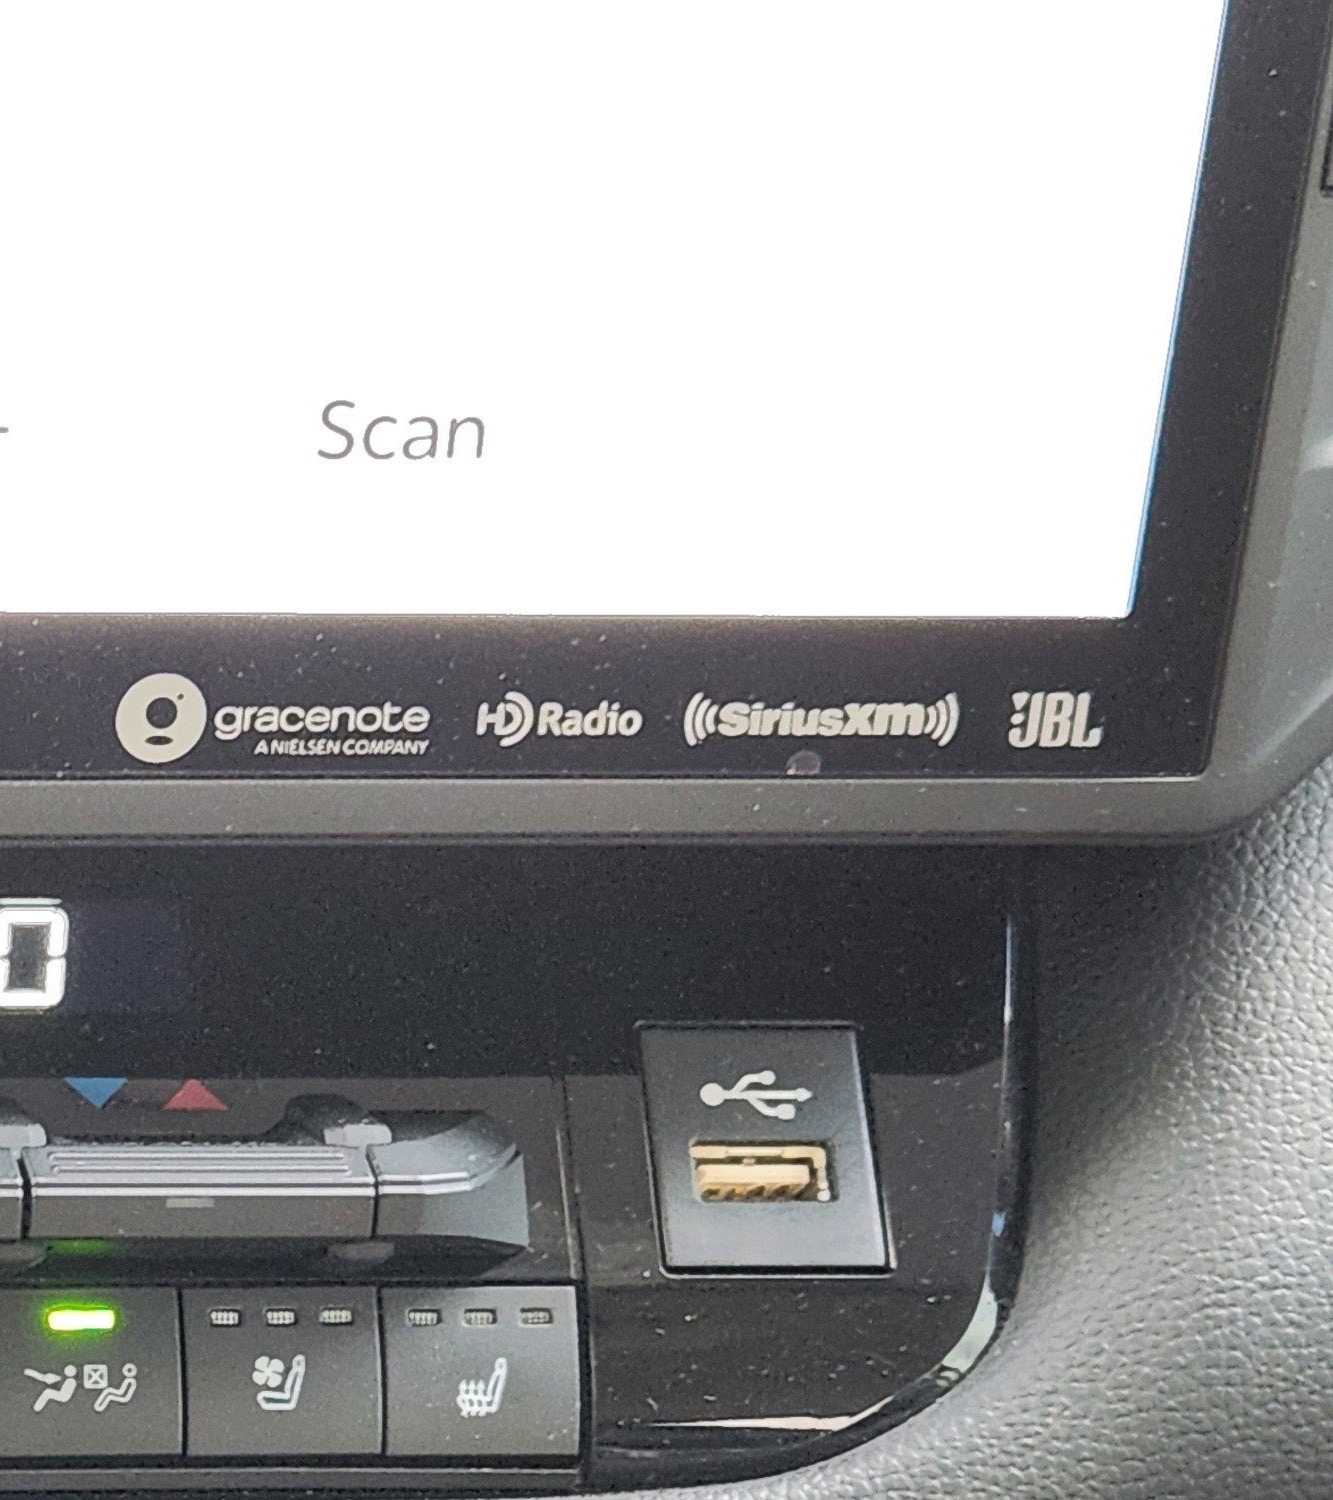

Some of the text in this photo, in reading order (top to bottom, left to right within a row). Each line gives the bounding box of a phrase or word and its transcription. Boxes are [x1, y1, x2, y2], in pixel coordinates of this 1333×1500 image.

[317, 400, 485, 460] Scan
[214, 702, 430, 742] gracenote
[537, 700, 642, 736] Radio
[1009, 692, 1101, 747] JBL
[254, 739, 429, 755] A NIELSEN COMPANY
